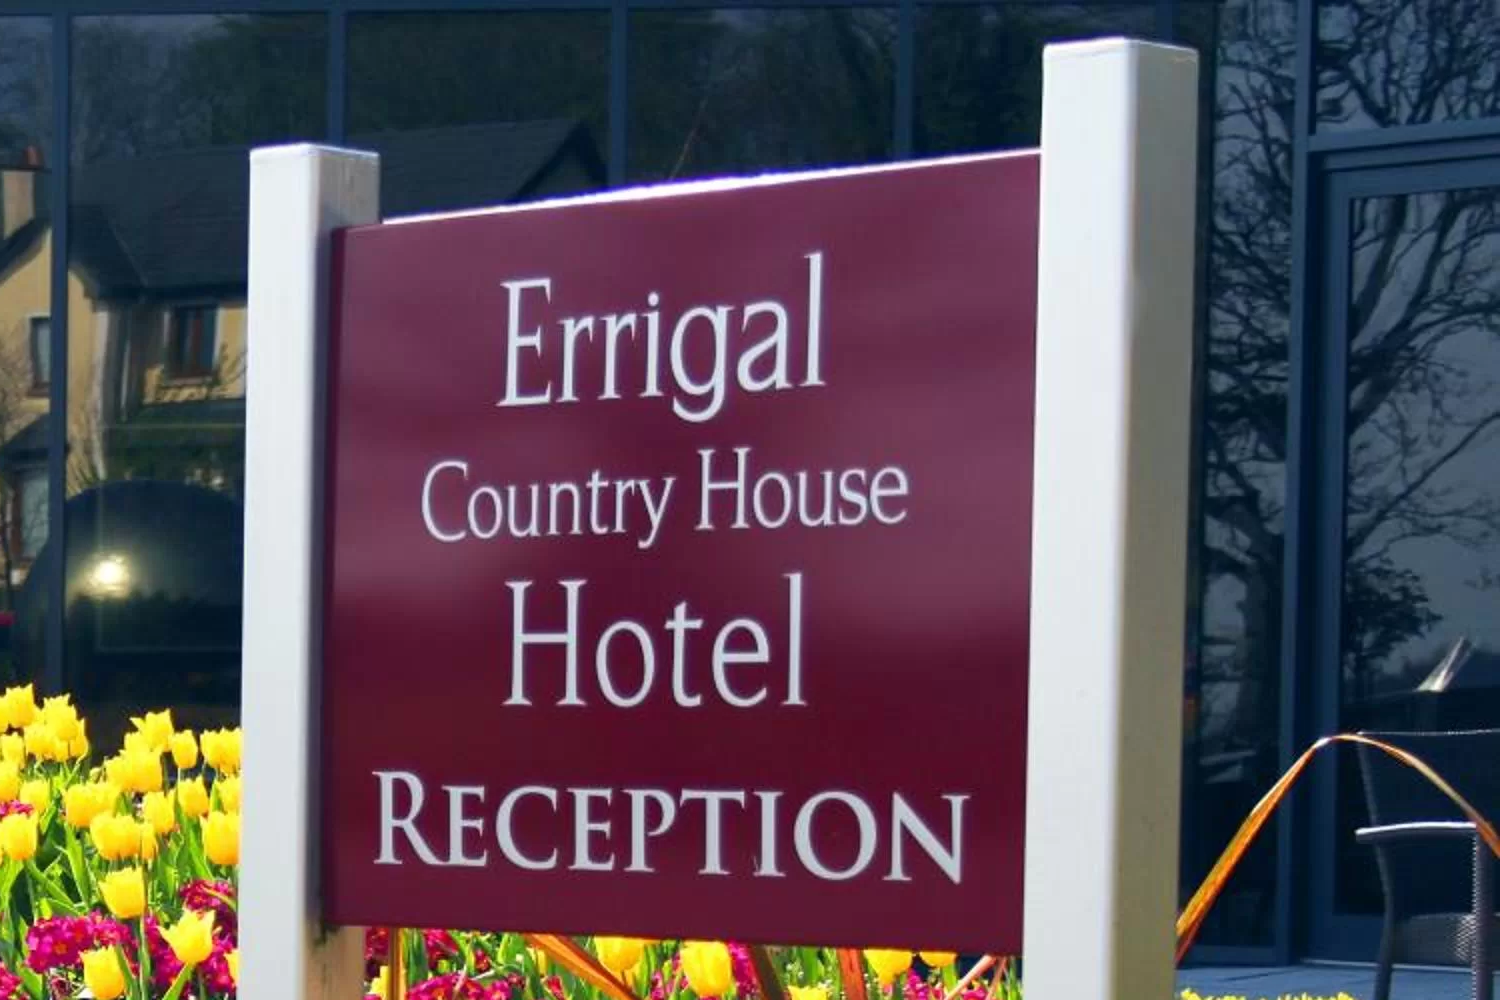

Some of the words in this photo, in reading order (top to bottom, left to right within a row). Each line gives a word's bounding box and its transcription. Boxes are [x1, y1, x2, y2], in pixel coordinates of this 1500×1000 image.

[496, 251, 826, 422] Errigal
[420, 460, 676, 549] Country
[694, 446, 910, 531] House
[501, 572, 808, 708] Hotel
[371, 769, 971, 885] RECEPTION
